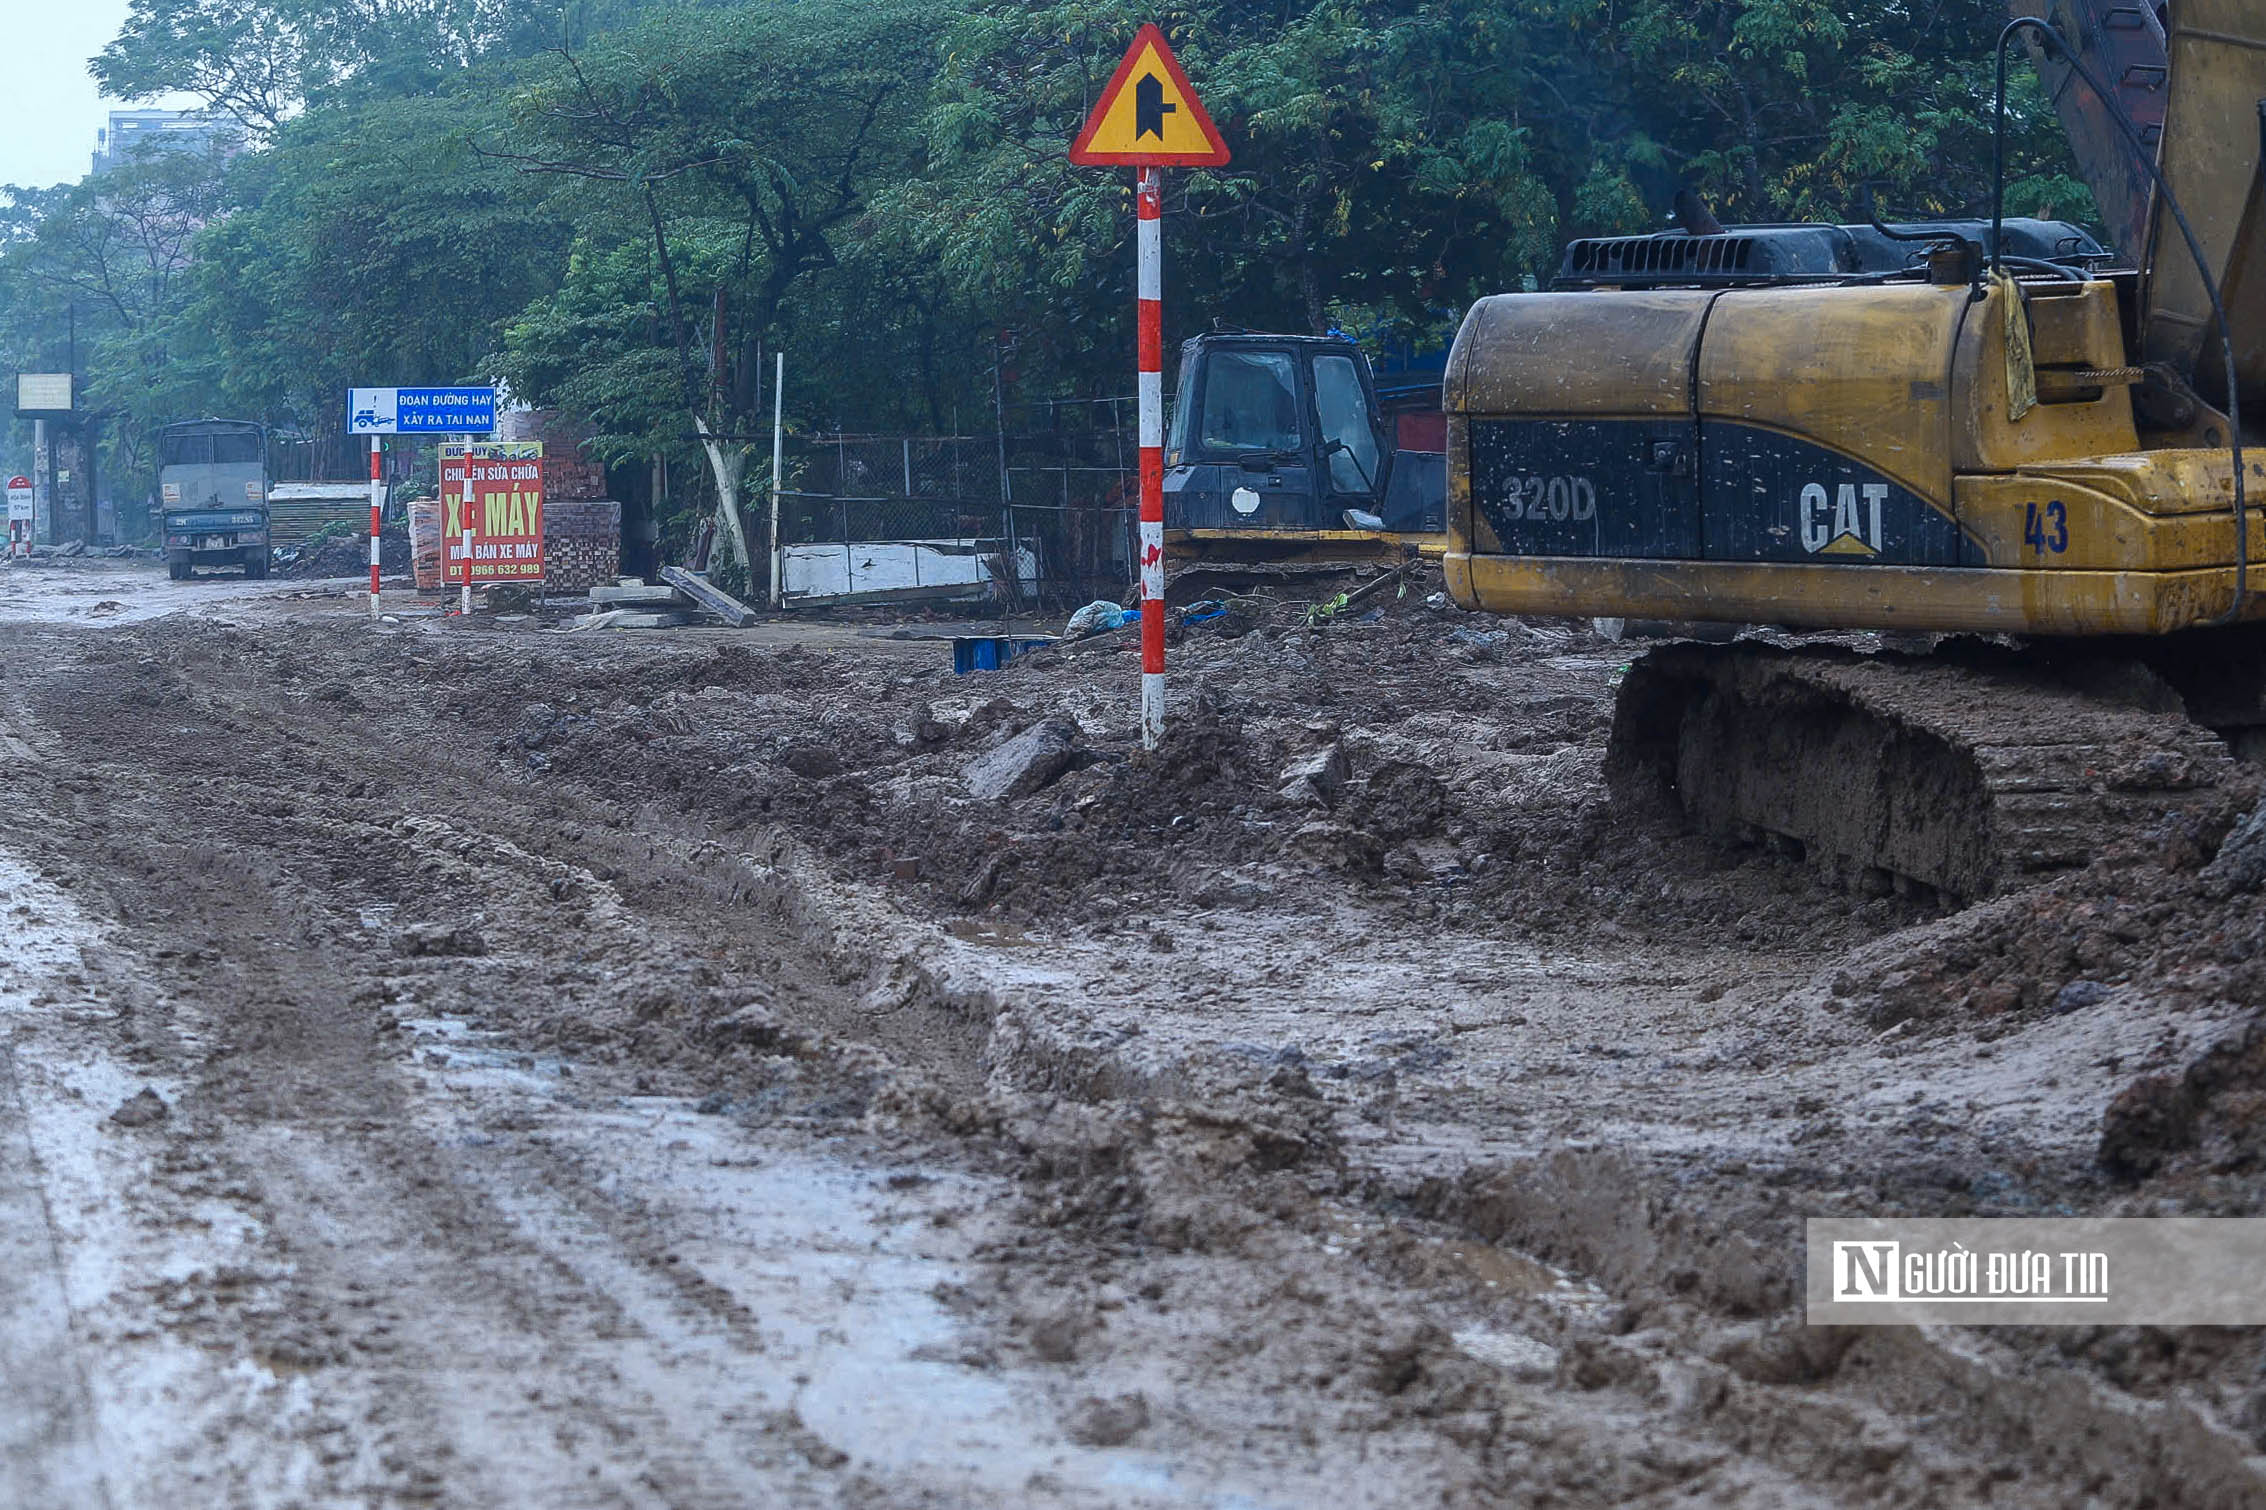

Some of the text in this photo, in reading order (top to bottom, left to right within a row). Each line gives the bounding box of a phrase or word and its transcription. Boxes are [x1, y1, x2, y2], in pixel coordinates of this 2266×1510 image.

[399, 392, 492, 407] ĐOẠN ĐƯỜNG HAY
[404, 411, 489, 427] XẢY RA TAI NẠN
[445, 463, 538, 480] CHUÊN SỬA CHỮA
[1501, 476, 1594, 520] 320D
[485, 482, 539, 537] MÁY
[1799, 482, 1889, 553] CAT
[2024, 500, 2068, 554] 43
[475, 542, 496, 559] BÁN
[500, 544, 512, 558] XE
[516, 541, 538, 558] MÁY
[497, 564, 517, 575] 632
[520, 564, 540, 574] 989
